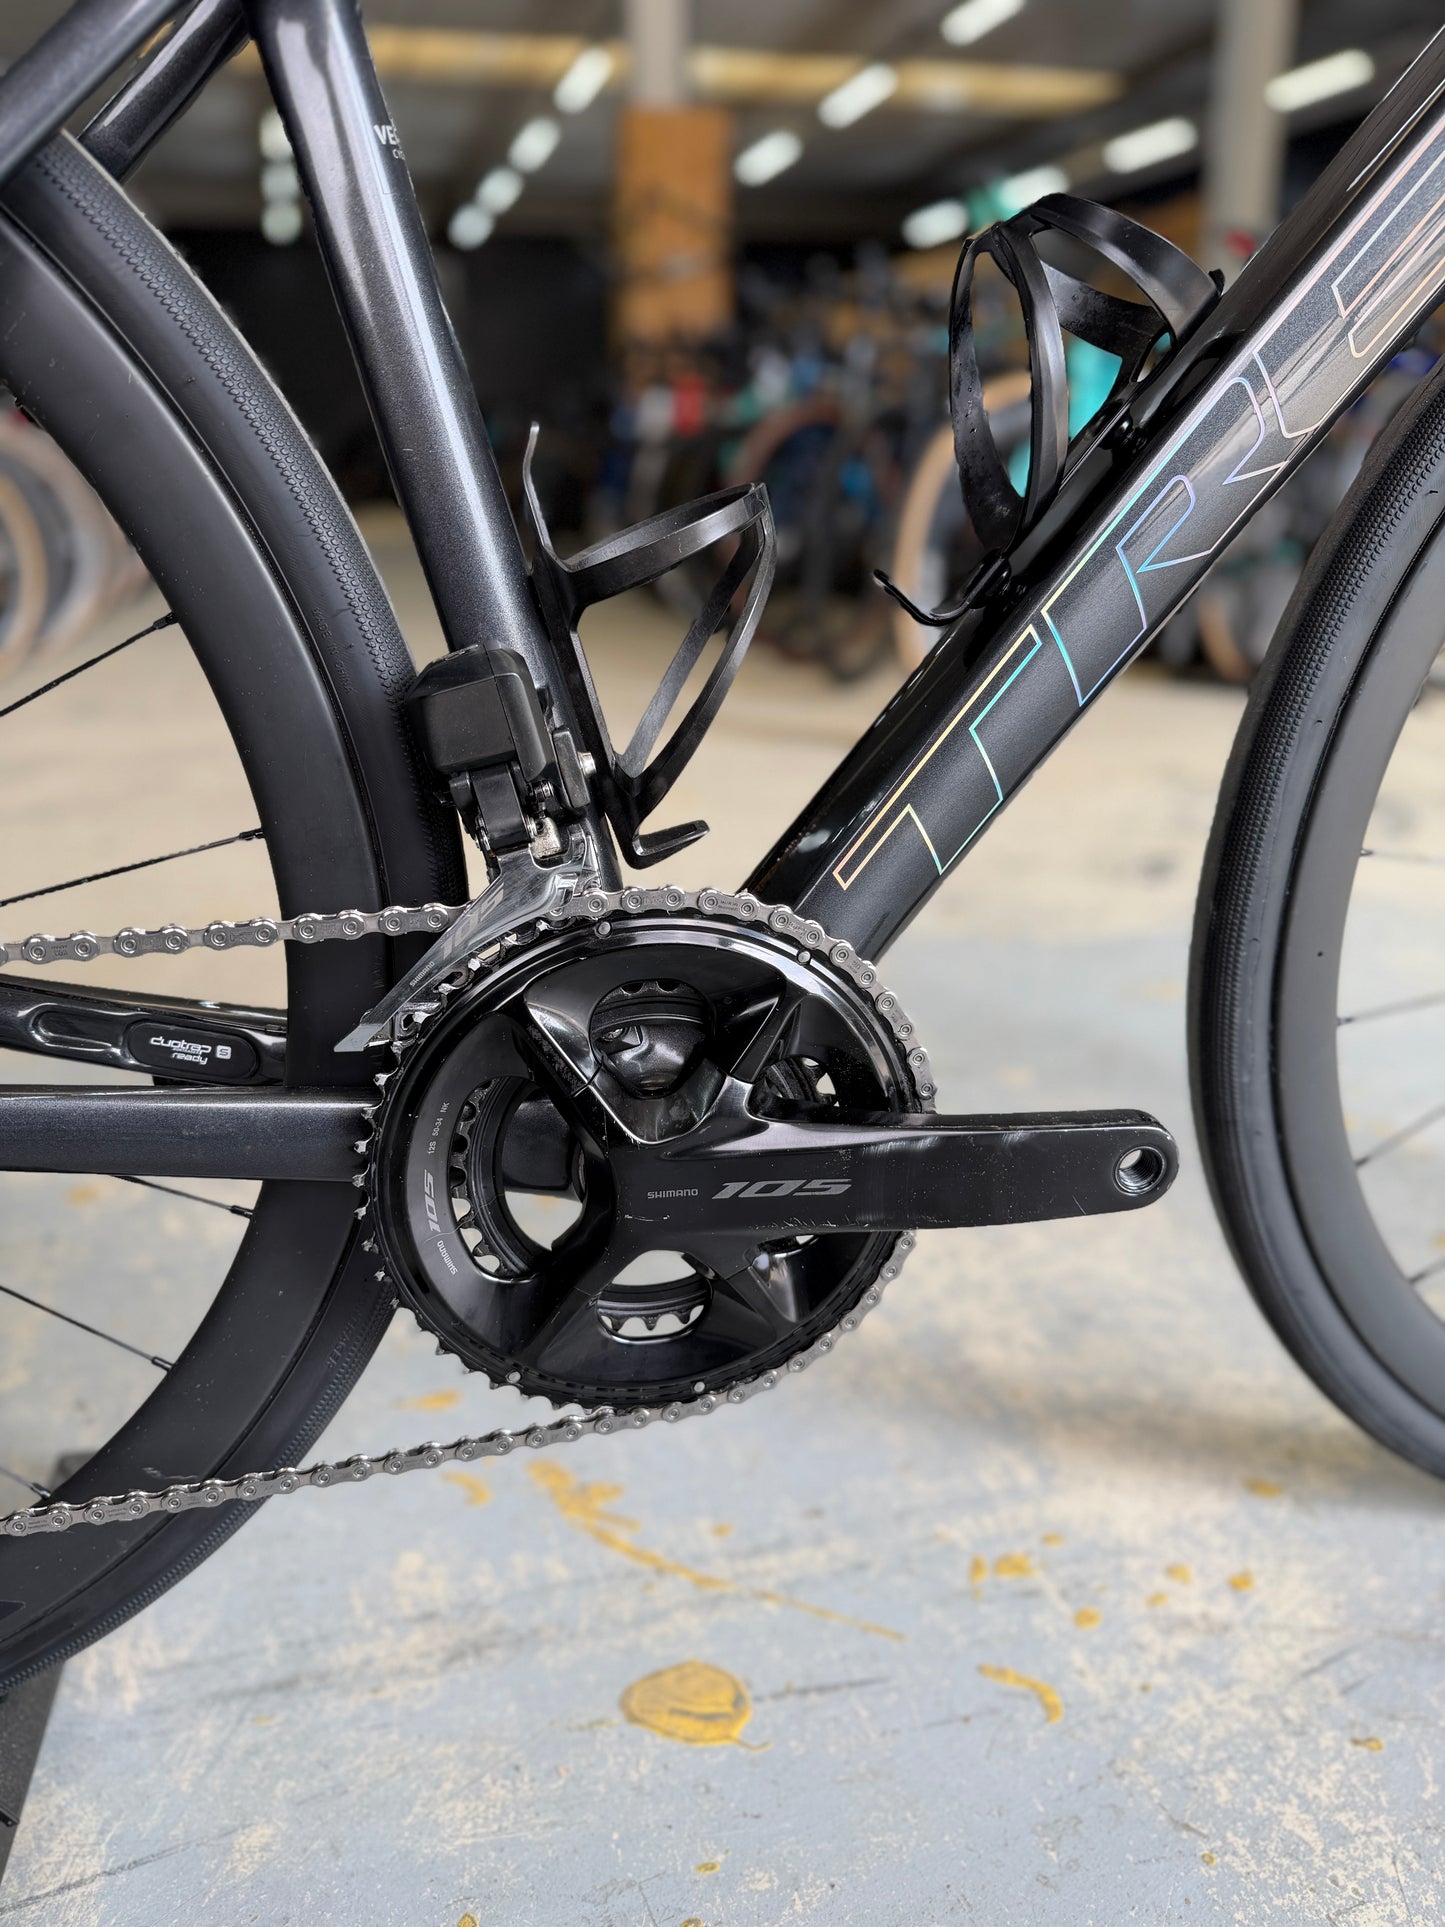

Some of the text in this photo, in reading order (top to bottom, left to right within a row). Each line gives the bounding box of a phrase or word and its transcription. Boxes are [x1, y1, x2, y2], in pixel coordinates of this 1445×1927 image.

[408, 881, 505, 988] SHIMANO 105
[171, 1052, 209, 1066] ready
[432, 1117, 444, 1137] 50-34
[440, 1101, 450, 1114] NK
[647, 1178, 853, 1200] SHIMANO 105
[424, 1168, 459, 1276] SHIMANO 105
